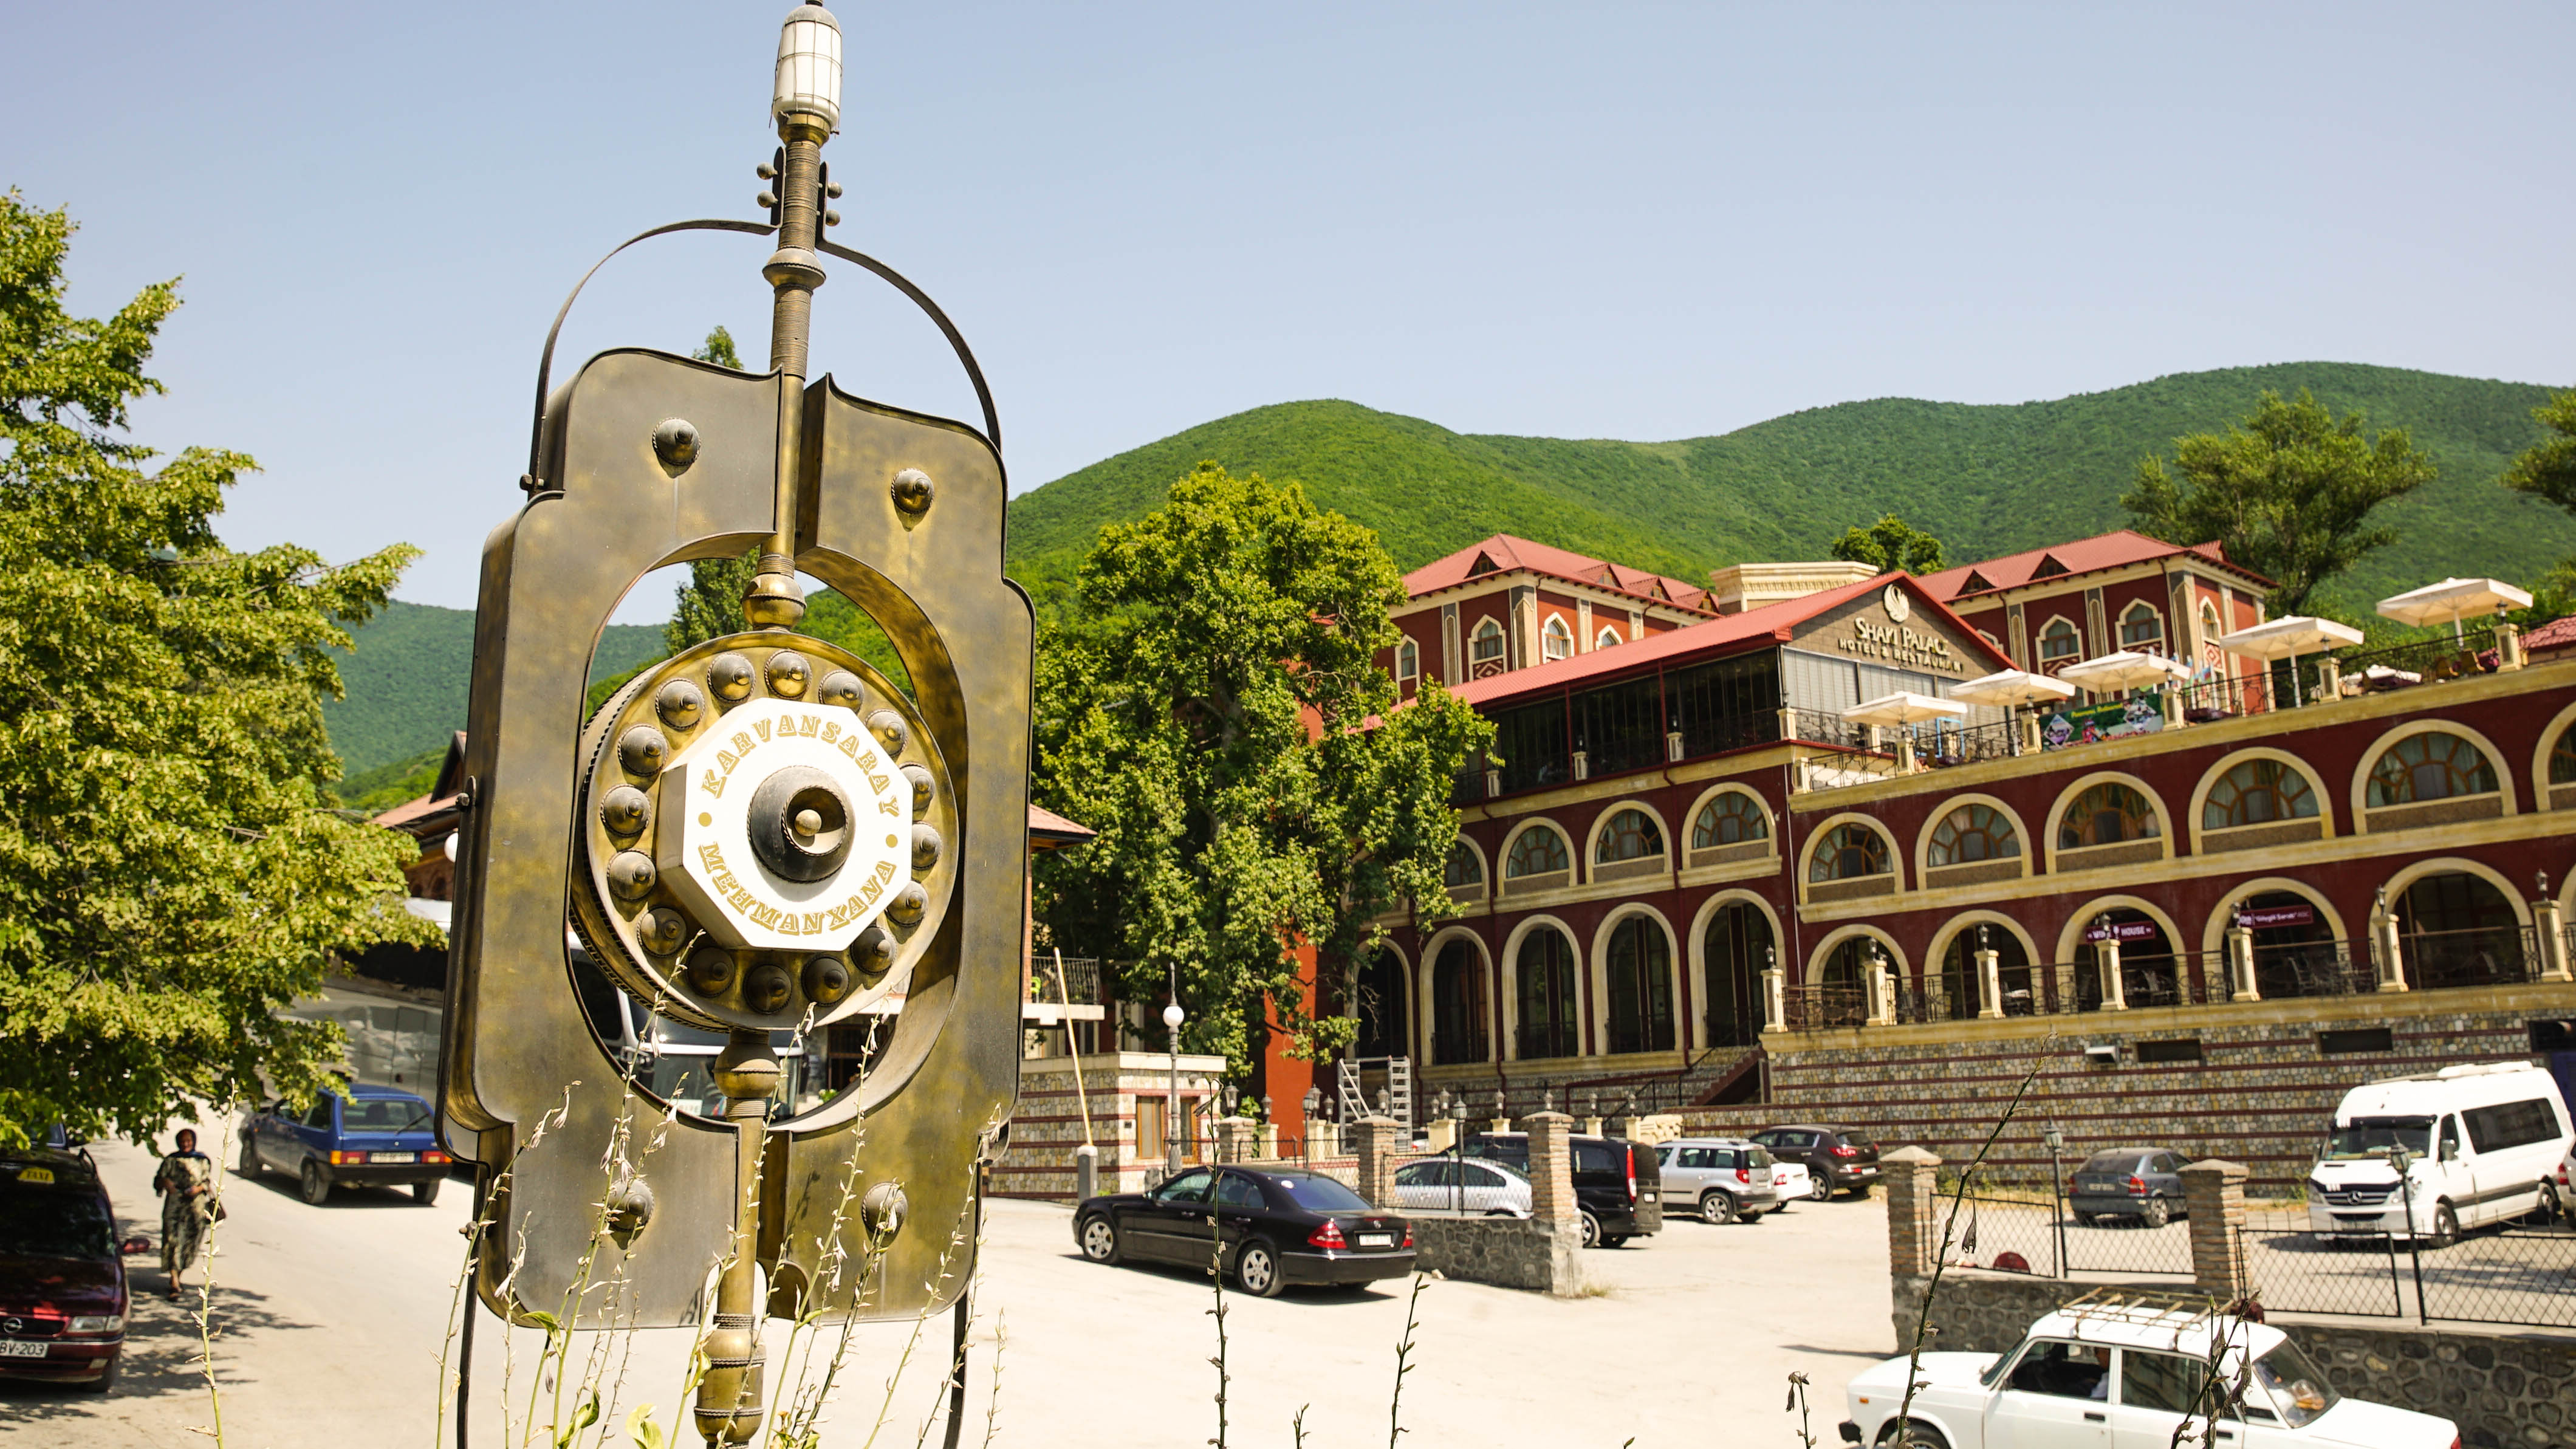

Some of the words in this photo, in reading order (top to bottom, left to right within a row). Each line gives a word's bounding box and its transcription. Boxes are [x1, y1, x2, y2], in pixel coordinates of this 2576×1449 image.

[1838, 637, 1877, 656] HOTEL
[1881, 645, 1889, 657] &
[1854, 617, 1898, 646] SHAKI
[1902, 626, 1951, 656] PALACE
[701, 714, 899, 817] KARVANSARAY
[698, 841, 897, 936] MEHMANXANA
